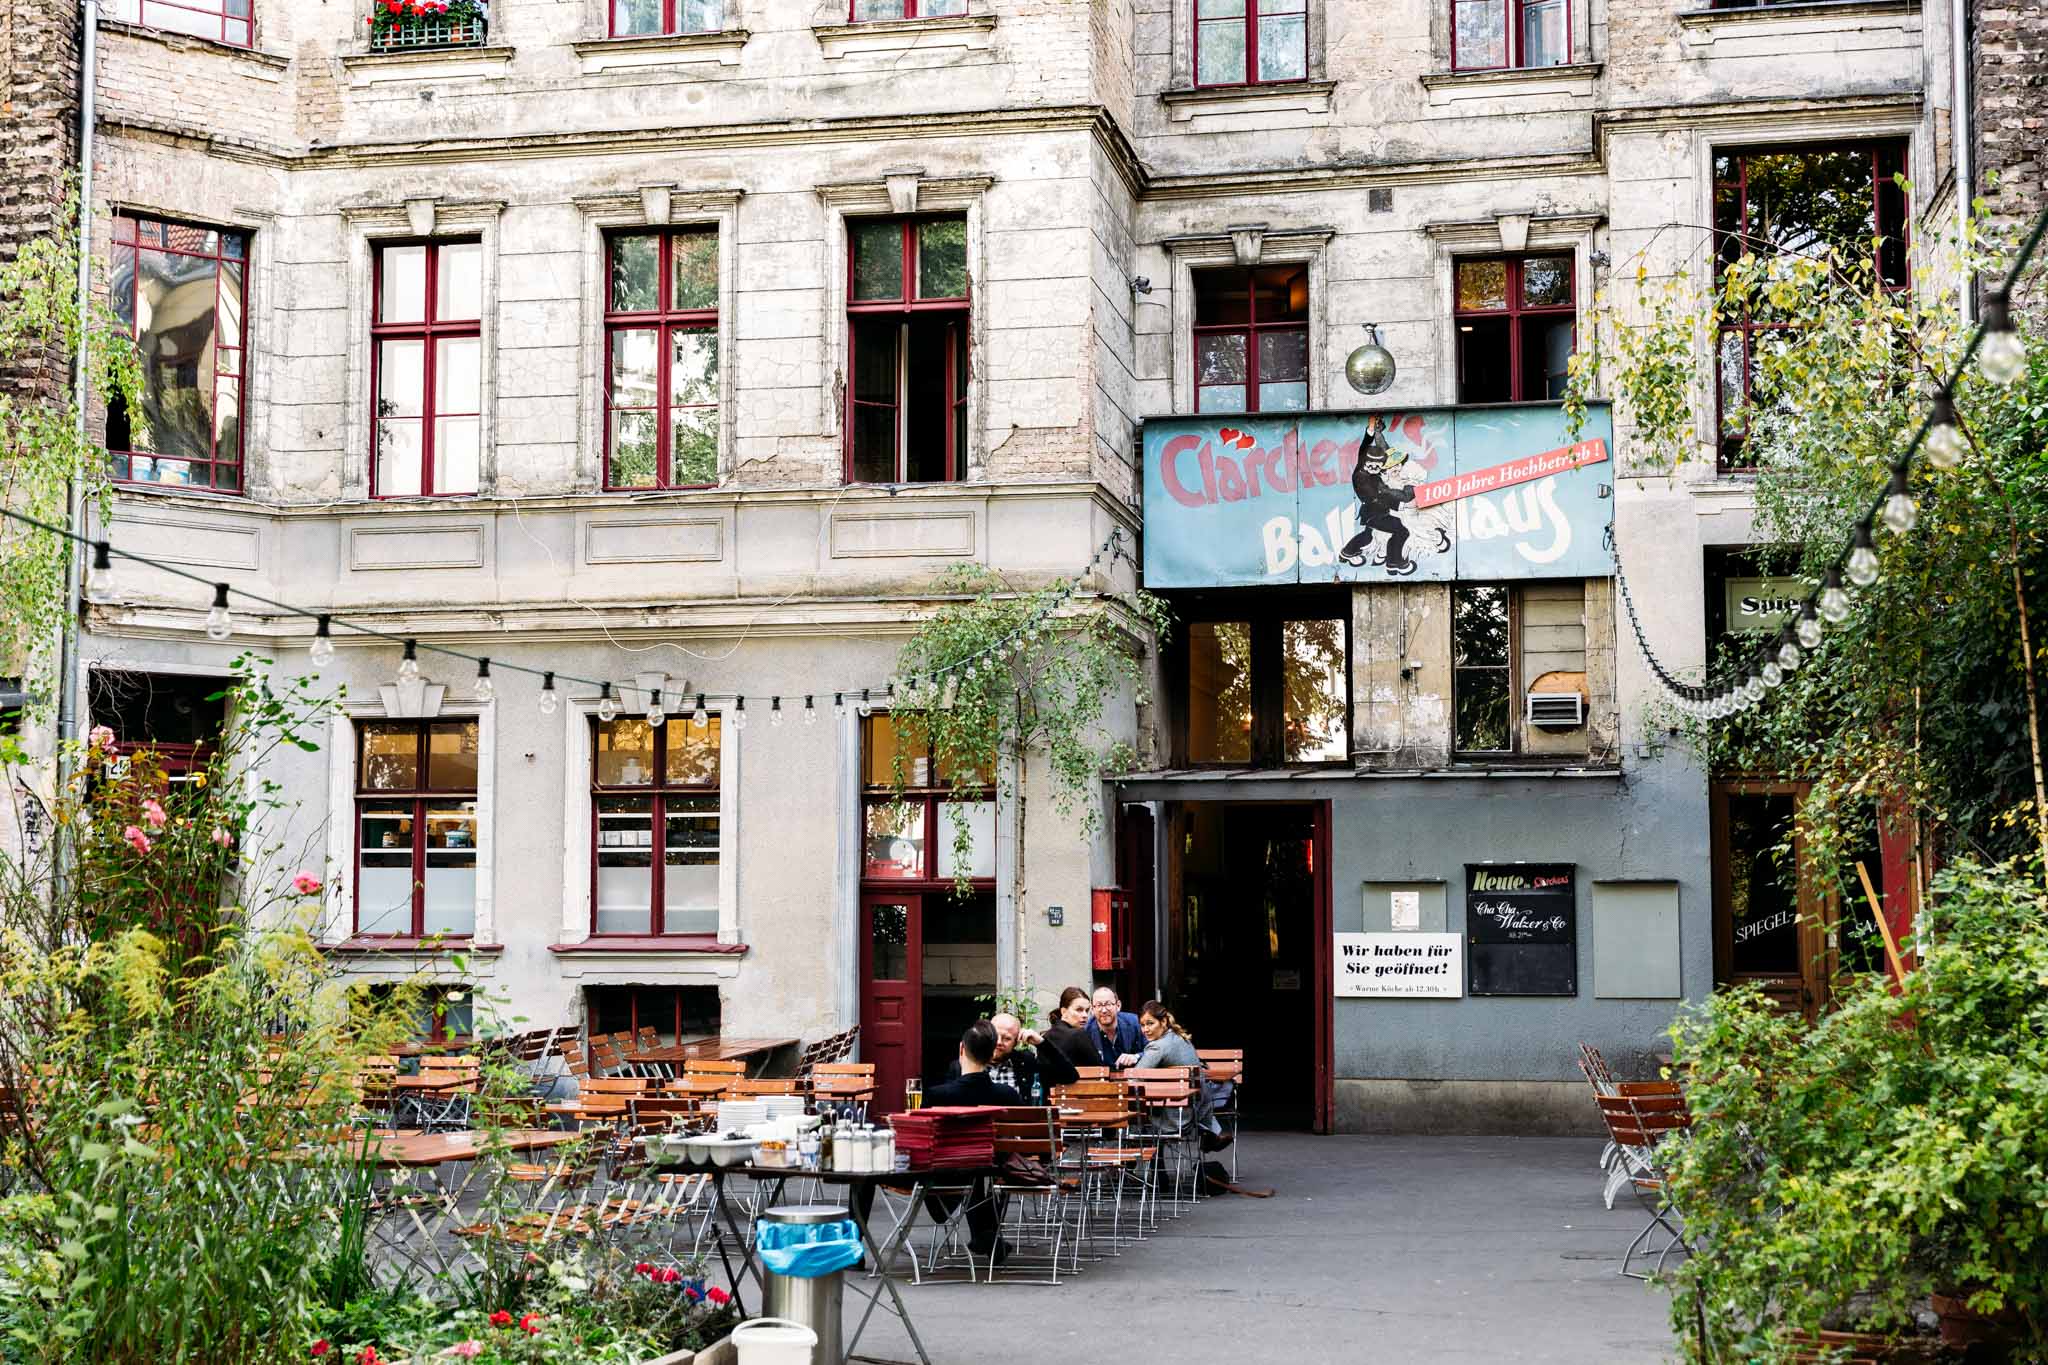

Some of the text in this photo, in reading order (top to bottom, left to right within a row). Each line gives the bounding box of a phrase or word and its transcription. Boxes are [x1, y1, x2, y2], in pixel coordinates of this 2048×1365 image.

[1424, 483, 1451, 502] 100
[1455, 473, 1495, 498] Jahre
[1473, 871, 1524, 891] Heute
[1474, 901, 1495, 916] Cha
[1494, 909, 1543, 929] Walzer
[1549, 915, 1567, 931] Co
[1342, 944, 1453, 957] Wir haben für
[1345, 962, 1448, 978] Sie geöffnet!
[1355, 985, 1379, 993] Warme
[1381, 984, 1402, 993] Küche
